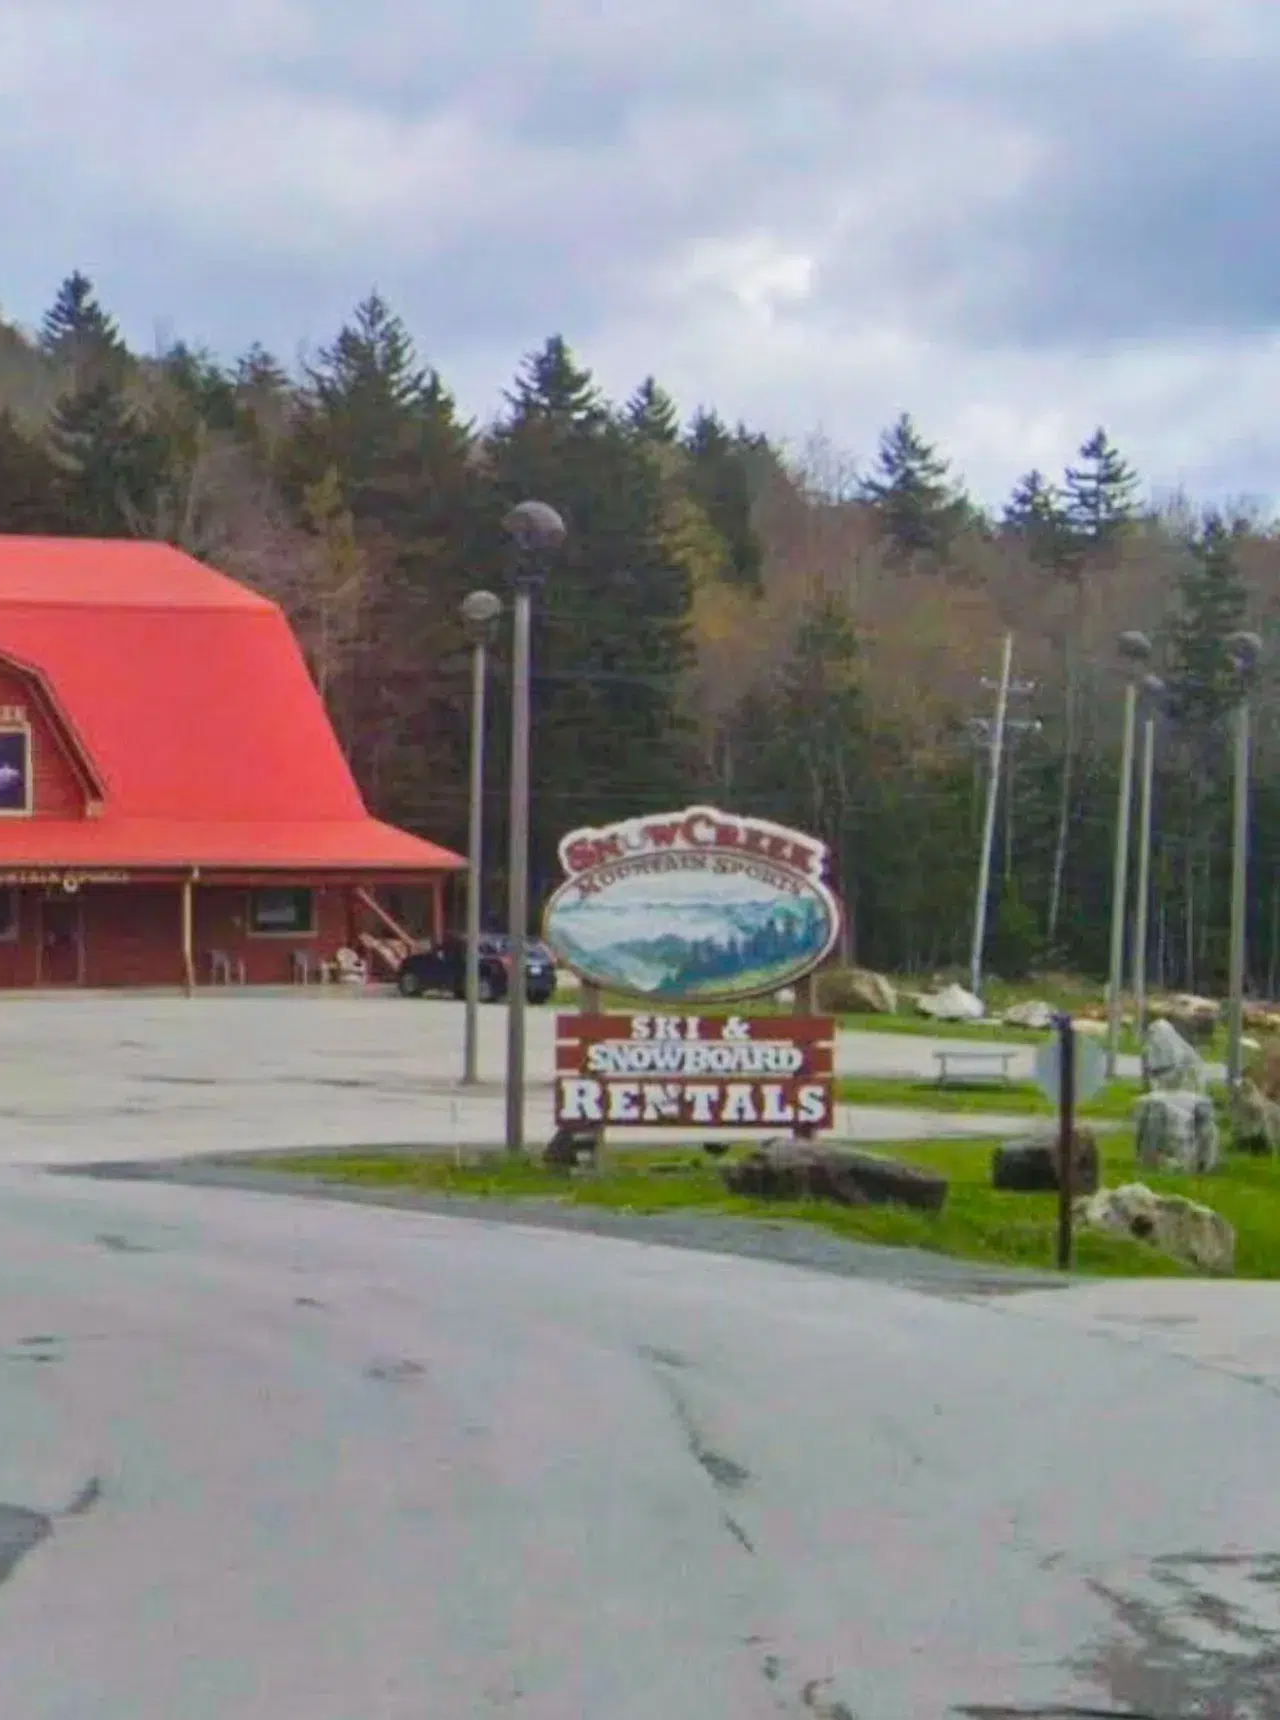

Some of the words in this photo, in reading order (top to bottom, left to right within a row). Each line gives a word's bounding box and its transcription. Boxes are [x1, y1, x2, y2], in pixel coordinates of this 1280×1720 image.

[631, 1015, 702, 1040] SKI
[722, 1015, 751, 1039] &
[587, 1041, 803, 1074] SNOWBOARD
[559, 1078, 826, 1122] RENTALS
